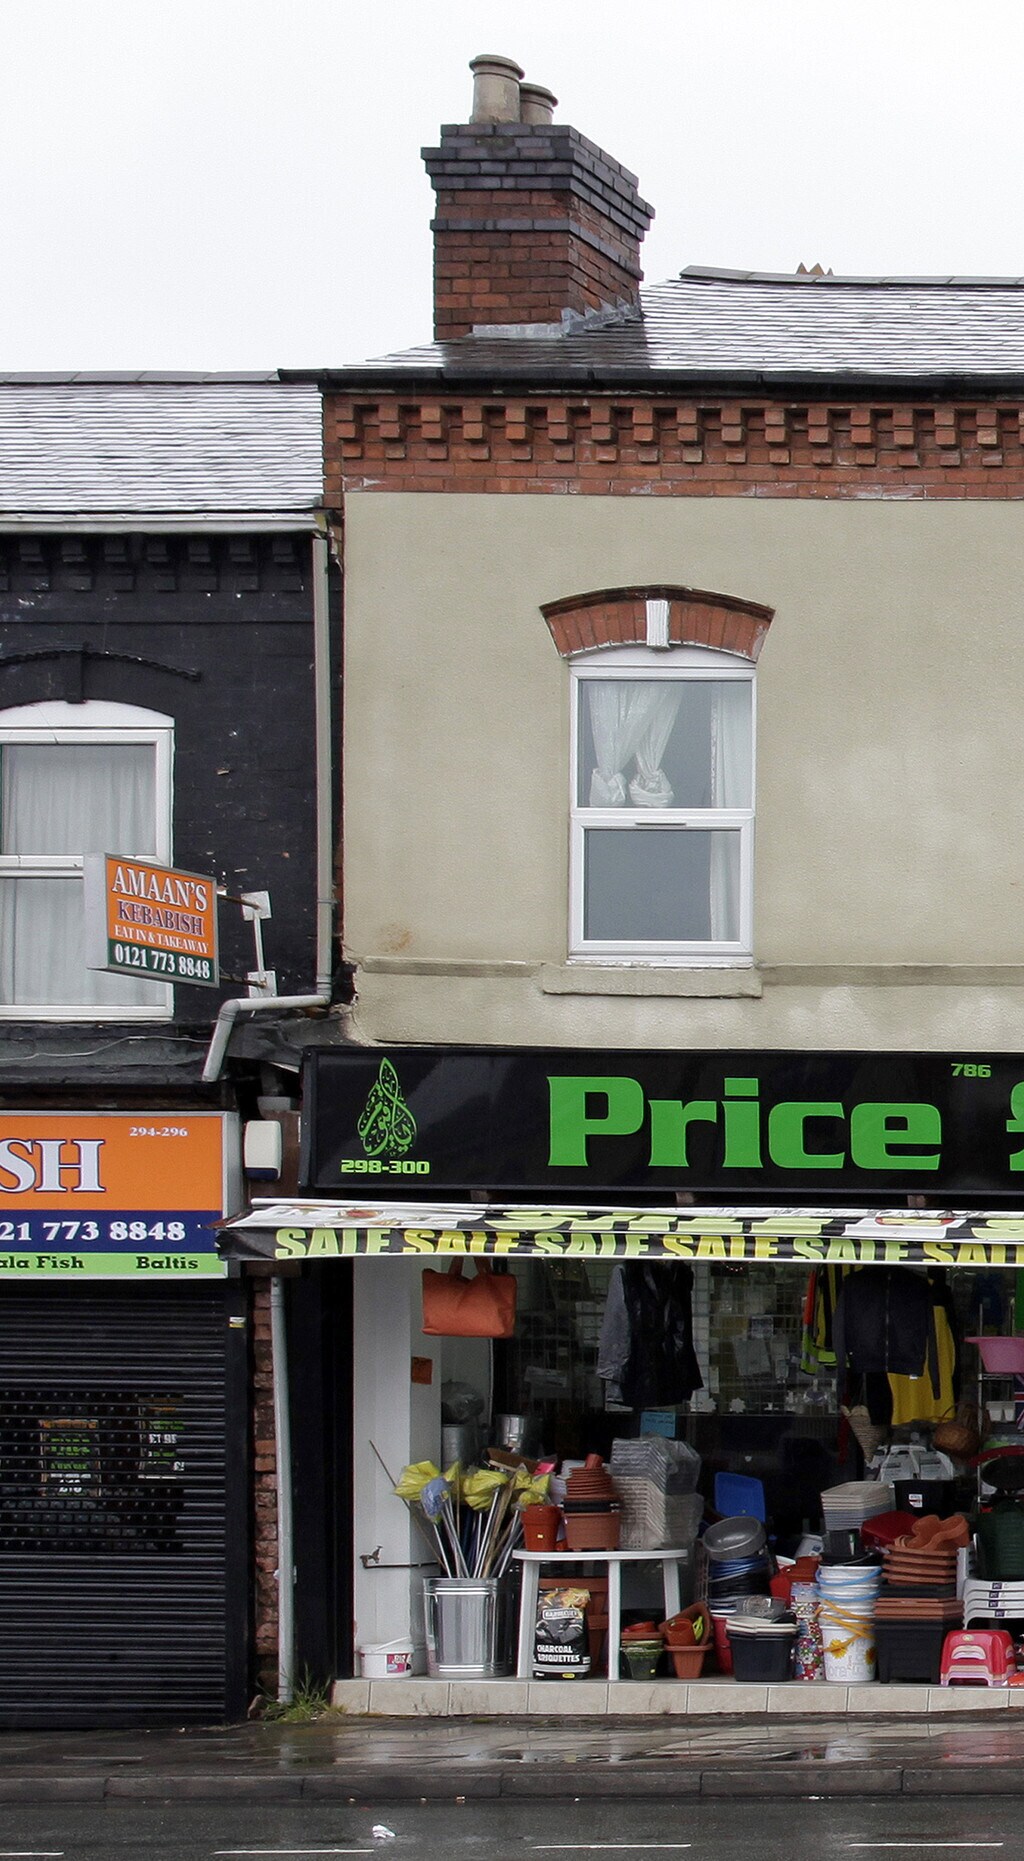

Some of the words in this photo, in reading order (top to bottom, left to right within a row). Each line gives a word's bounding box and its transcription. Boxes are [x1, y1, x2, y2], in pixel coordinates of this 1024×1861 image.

[112, 866, 208, 912] AMAAN'S
[118, 899, 204, 936] KEBABISH
[115, 925, 135, 940] EAT
[136, 929, 147, 942] IN
[148, 934, 156, 944] &
[156, 933, 209, 954] TAKEAWAY
[115, 944, 148, 968] 0121
[151, 951, 176, 973] 773
[179, 956, 211, 979] 8848
[950, 1064, 992, 1078] 786
[129, 1127, 188, 1137] 294-296
[547, 1076, 942, 1170] Price
[341, 1160, 430, 1174] 298-300
[43, 1221, 100, 1241] 773
[109, 1221, 186, 1241] 8848
[275, 1228, 391, 1260] SALE
[404, 1228, 520, 1254] SALE
[532, 1232, 650, 1256] SALE
[662, 1234, 779, 1258] SALE
[792, 1236, 910, 1262] SALE
[37, 1256, 84, 1269] Fish
[136, 1256, 199, 1269] Baltis
[537, 1644, 573, 1654] CHARCOAL
